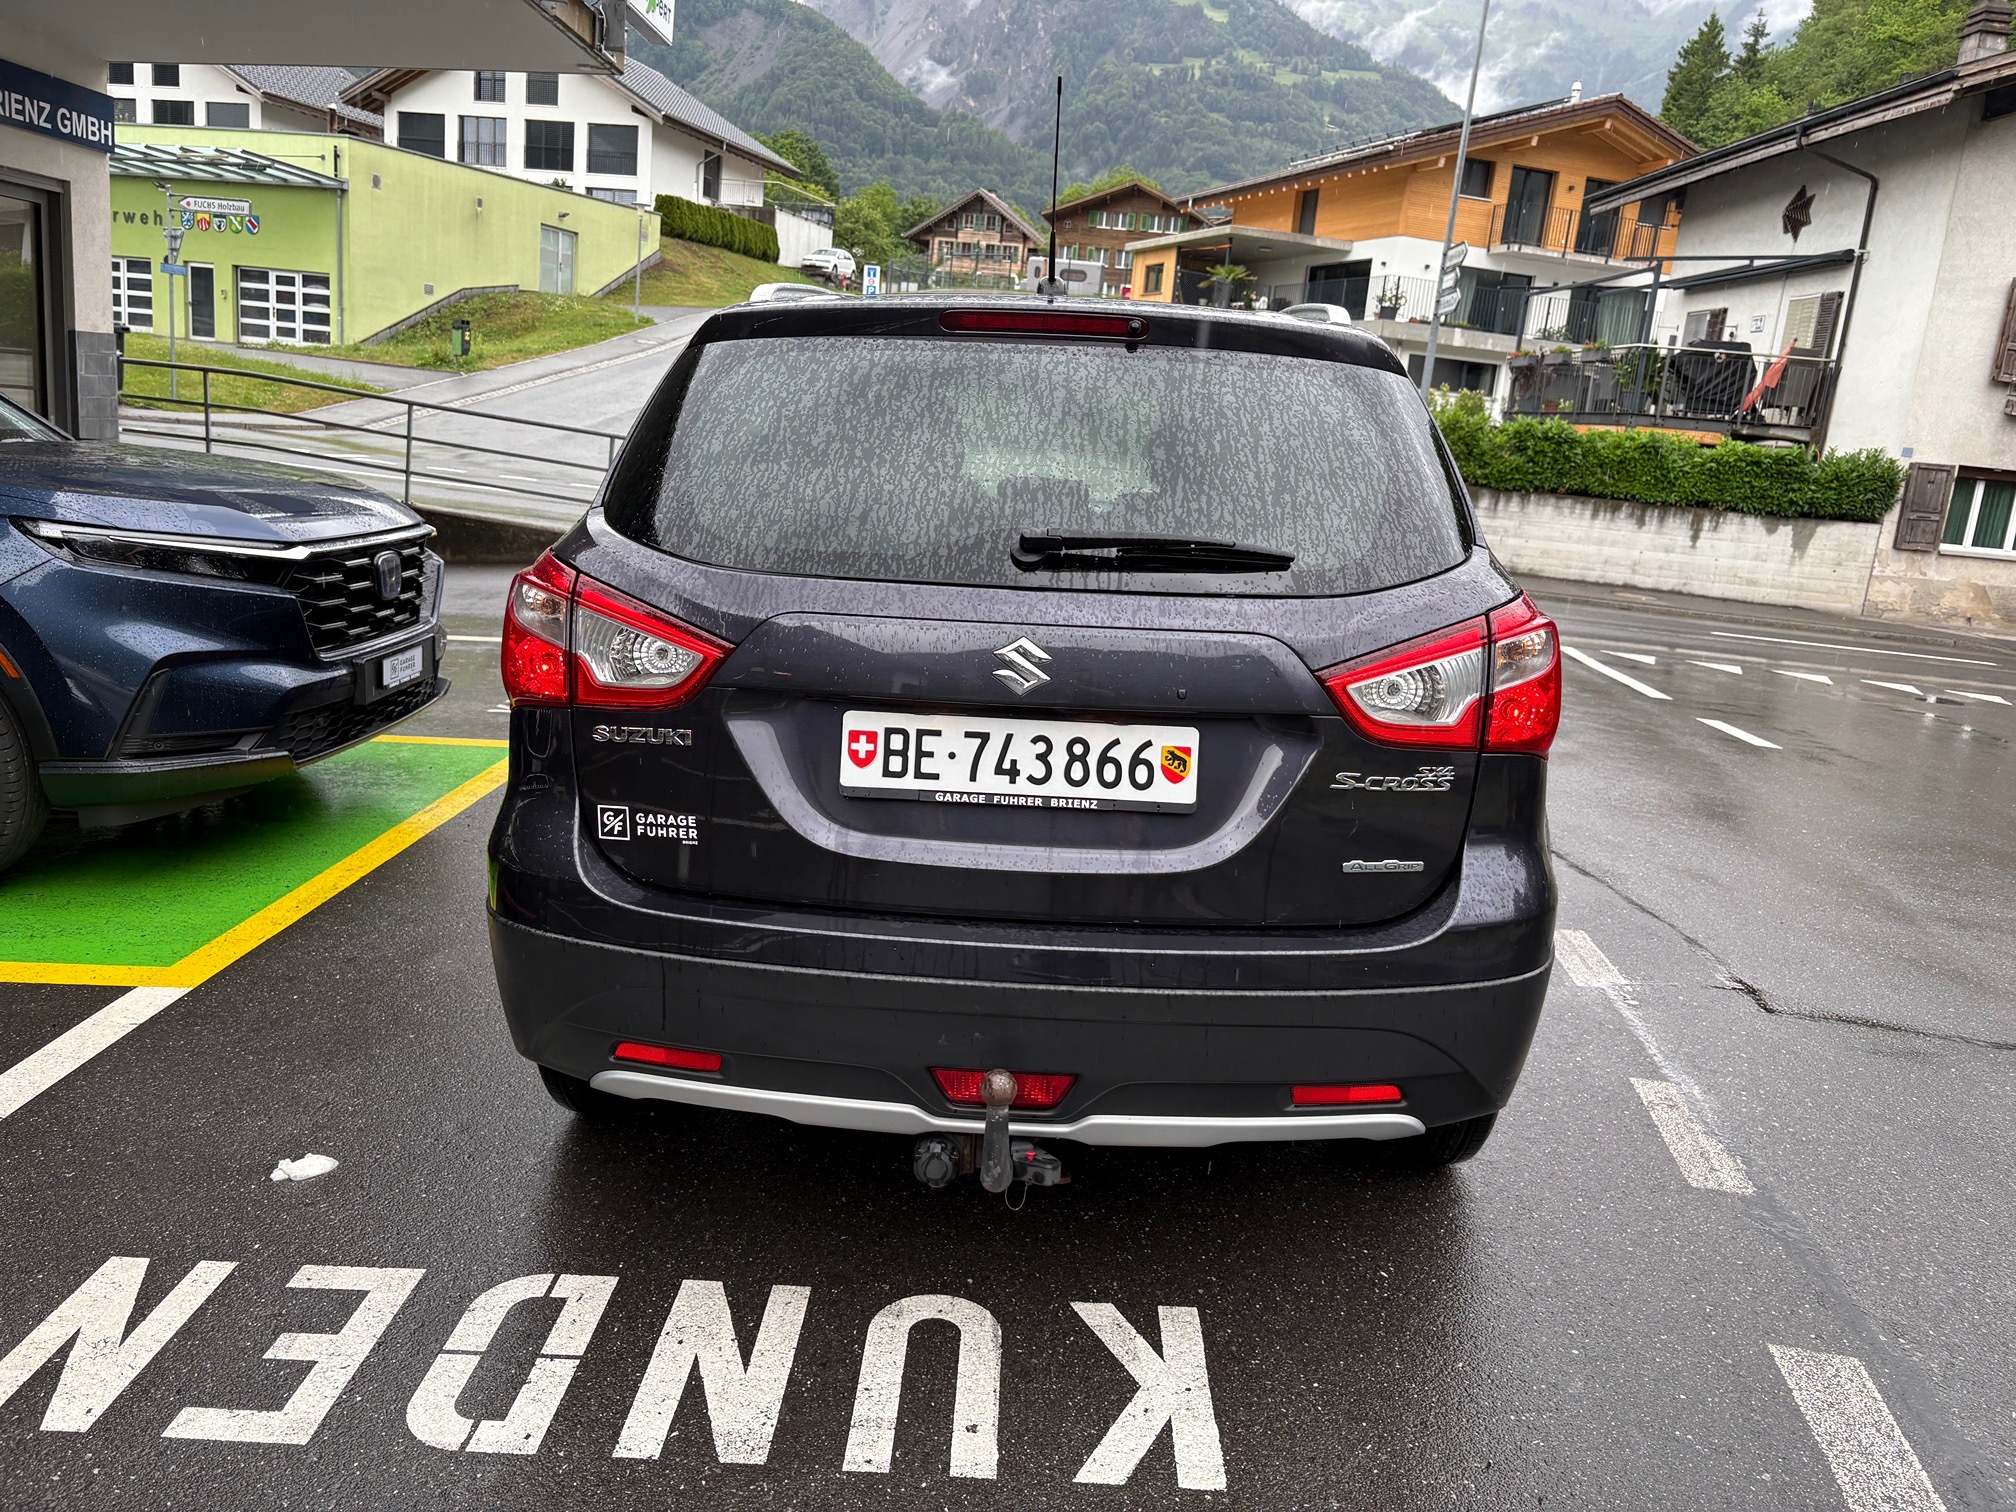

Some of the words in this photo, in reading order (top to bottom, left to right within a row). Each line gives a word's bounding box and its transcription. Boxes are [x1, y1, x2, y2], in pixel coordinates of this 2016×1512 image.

[57, 107, 112, 146] GMBH
[193, 200, 216, 209] FUCHS
[217, 202, 245, 212] Holzbau
[112, 210, 174, 227] rweh
[592, 725, 692, 746] SUZUKI
[1415, 766, 1455, 777] SX4
[1329, 772, 1454, 791] S-CROSS
[935, 792, 986, 804] GARAGE
[993, 795, 1043, 807] FUHRER
[1050, 798, 1098, 809] BRIENZ
[635, 812, 697, 827] GARAGE
[636, 825, 698, 839] FUHRER
[0, 1256, 1227, 1491] KUNDEN
